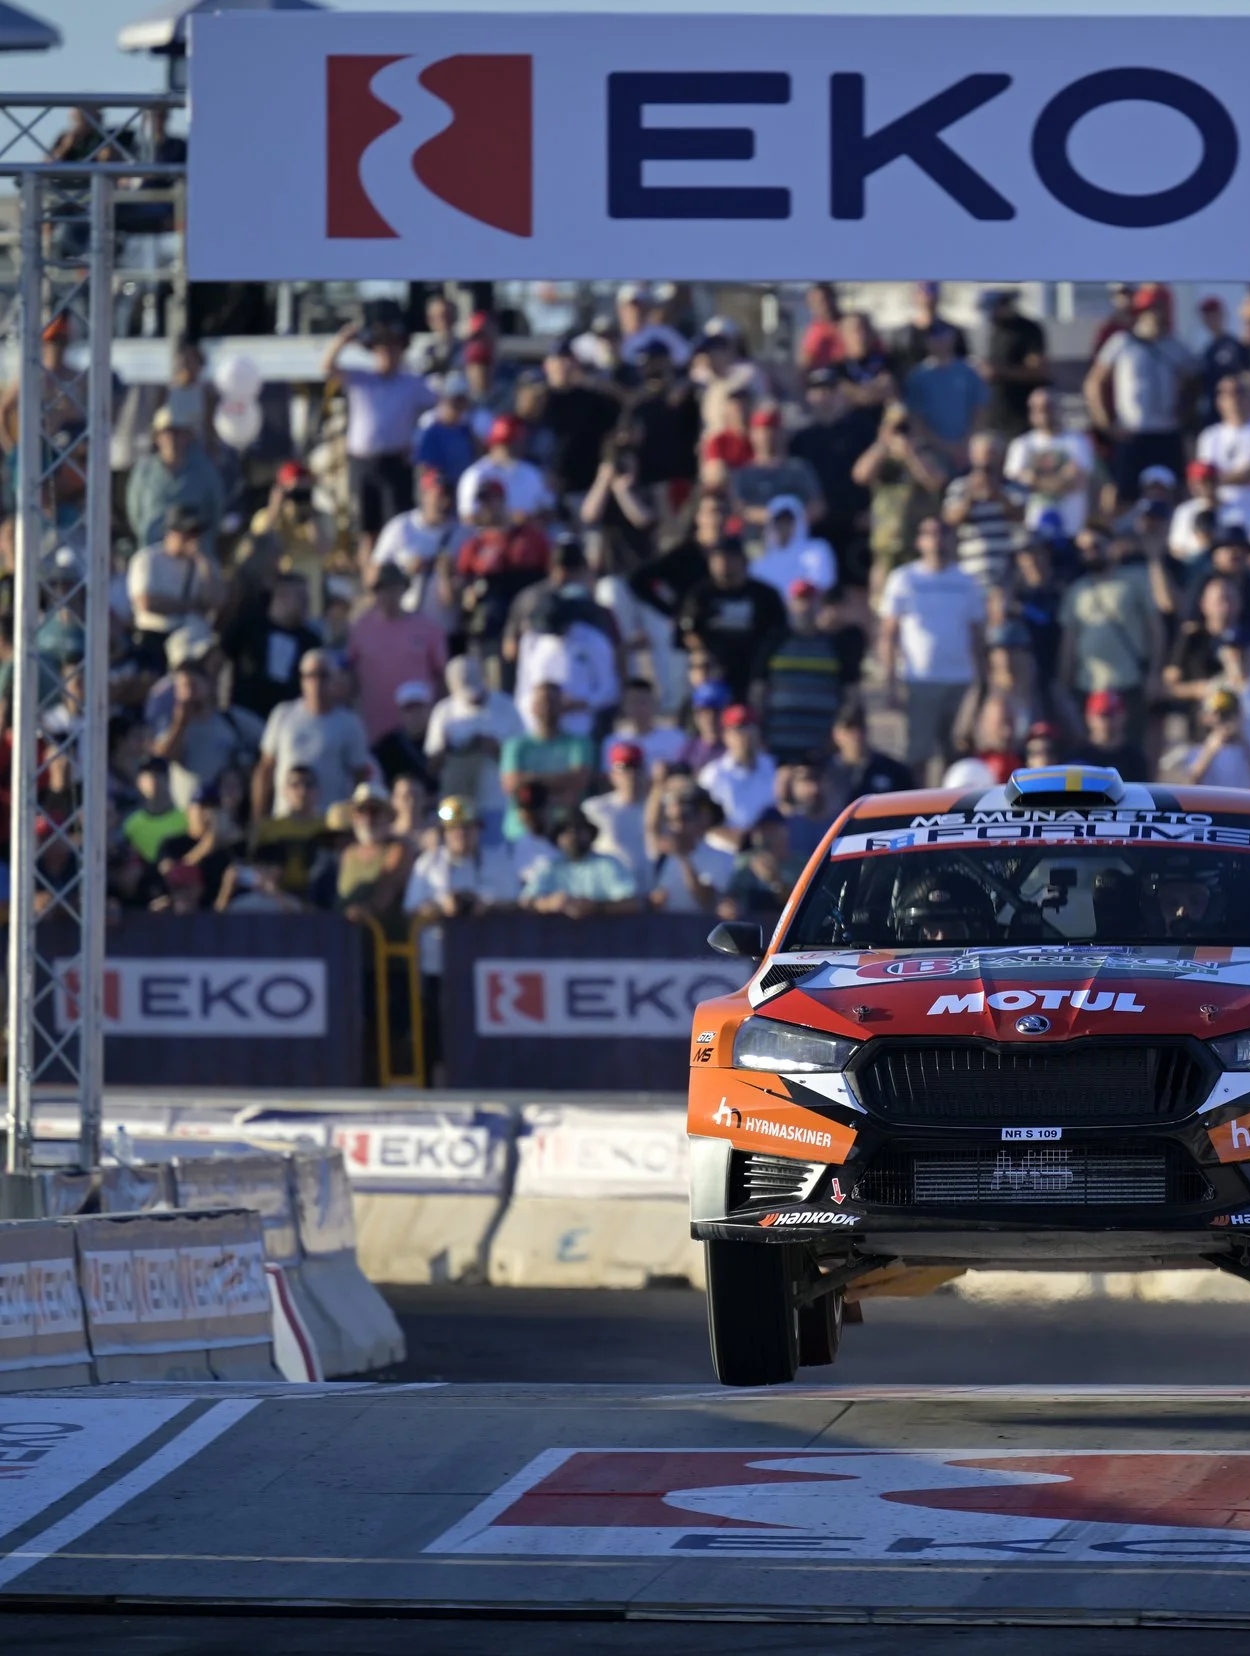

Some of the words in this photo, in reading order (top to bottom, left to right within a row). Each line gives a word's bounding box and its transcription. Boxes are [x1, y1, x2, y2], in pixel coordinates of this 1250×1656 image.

[606, 66, 1240, 228] EKO
[910, 812, 966, 829] MS
[972, 810, 1213, 825] MUNARETTO
[139, 973, 315, 1020] EKO
[927, 989, 1145, 1015] MOTUL
[745, 1117, 832, 1147] HYRMASKINER
[1005, 1129, 1022, 1138] NR
[1026, 1129, 1034, 1138] S
[1038, 1129, 1058, 1138] 109
[379, 1135, 481, 1169] EKO
